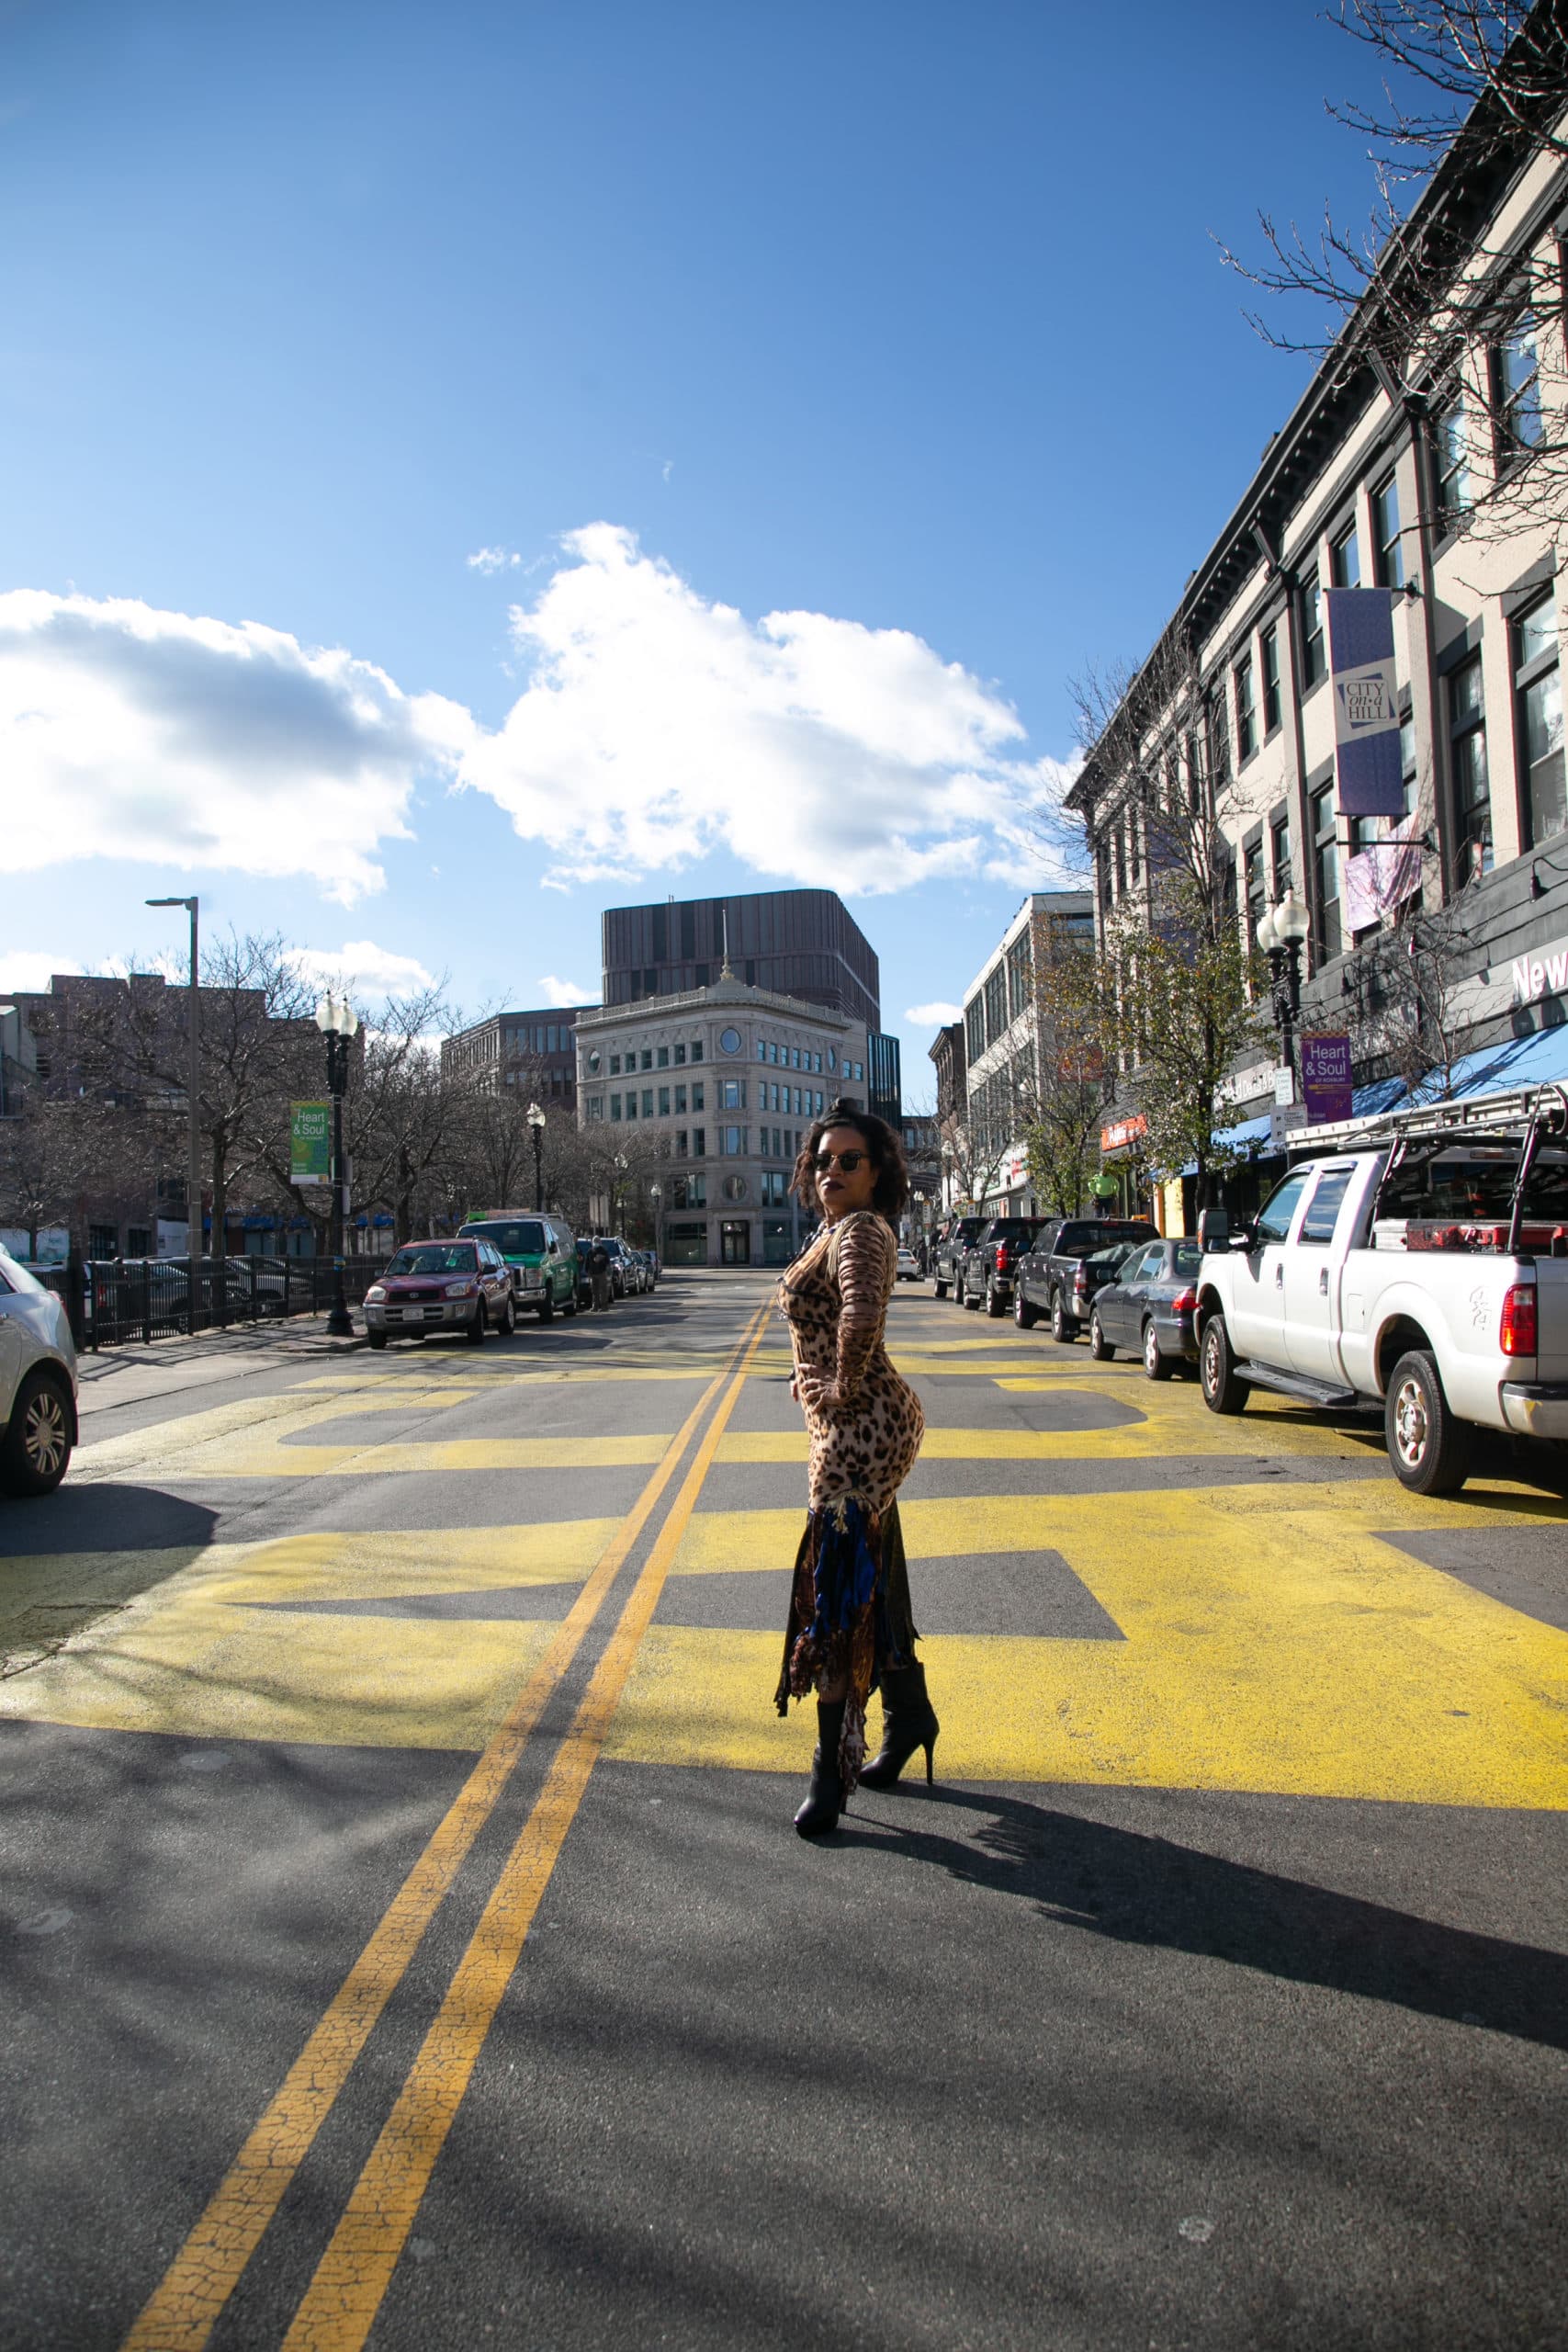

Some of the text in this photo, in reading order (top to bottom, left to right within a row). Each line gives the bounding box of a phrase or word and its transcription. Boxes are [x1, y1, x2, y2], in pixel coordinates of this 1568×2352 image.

[1347, 684, 1384, 695] CITY
[1348, 707, 1387, 718] HILL
[1311, 1045, 1346, 1058] Heart
[1305, 1061, 1346, 1076] & Soul
[297, 1112, 325, 1123] Heart
[293, 1124, 324, 1135] & Soul
